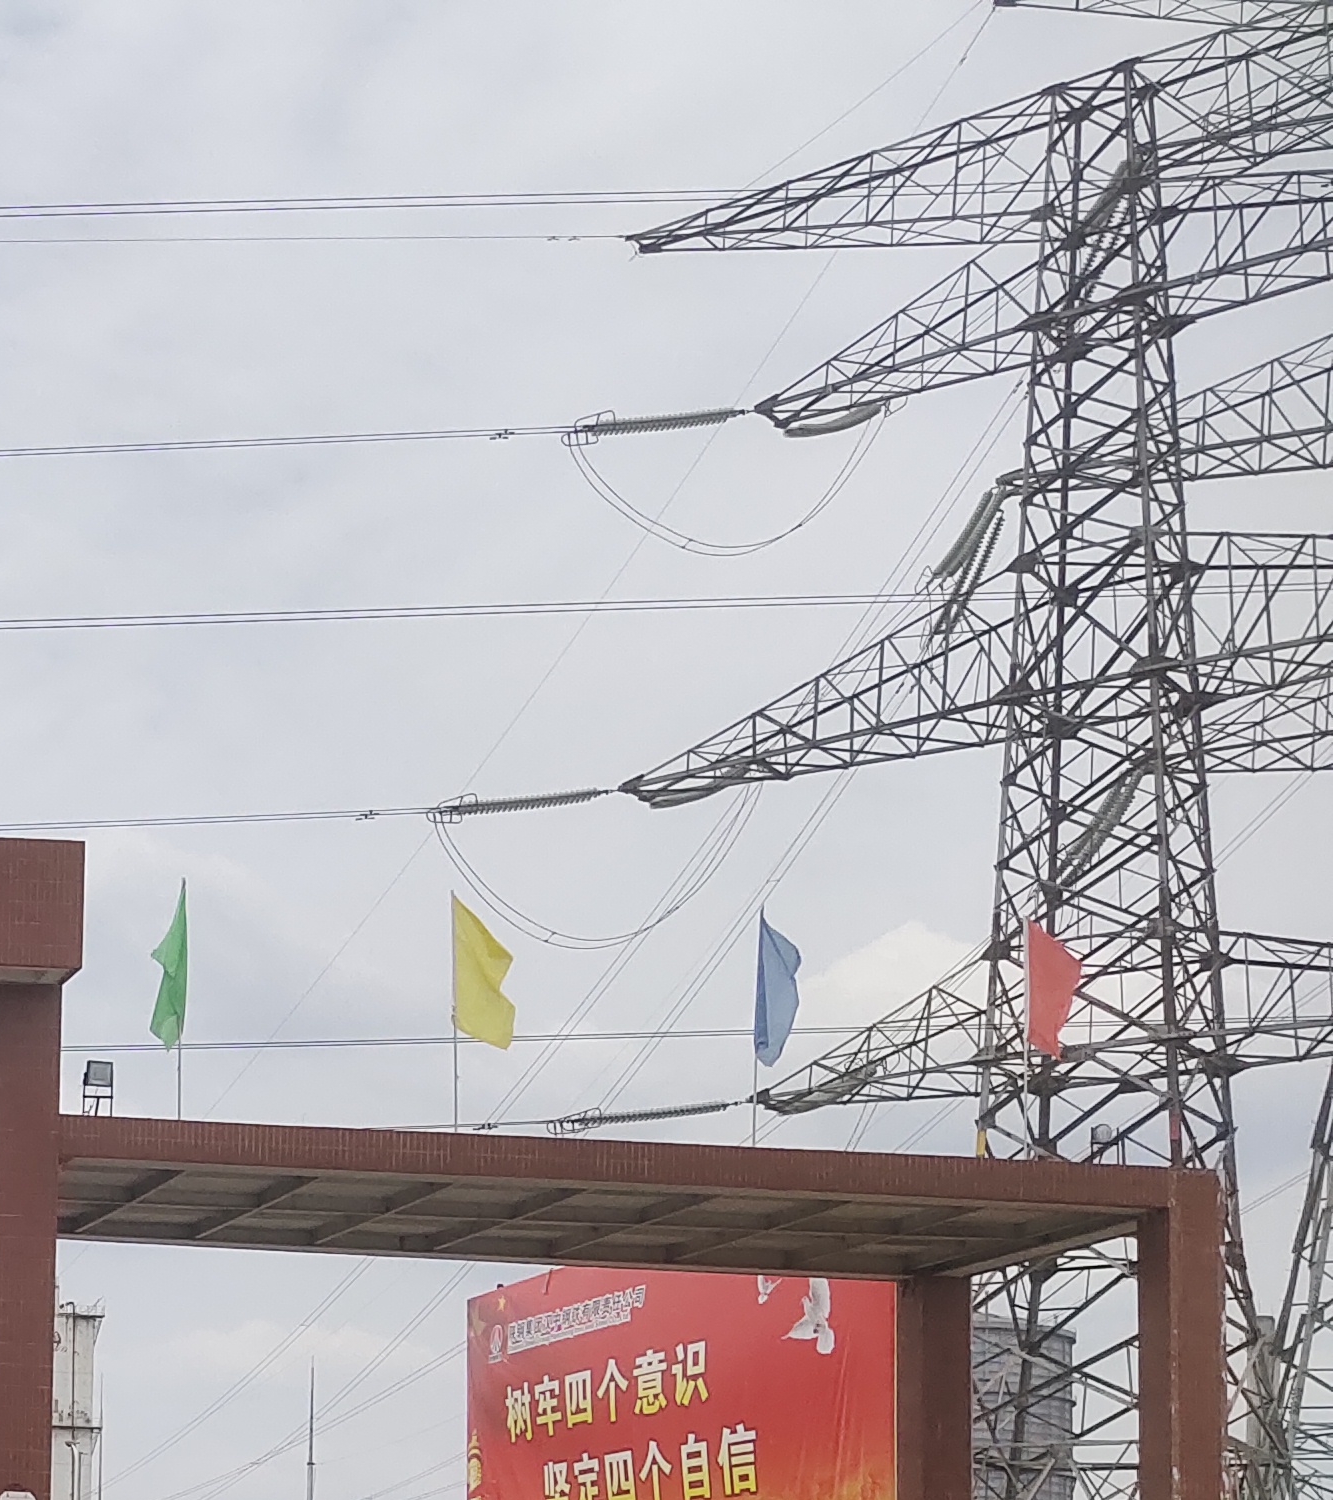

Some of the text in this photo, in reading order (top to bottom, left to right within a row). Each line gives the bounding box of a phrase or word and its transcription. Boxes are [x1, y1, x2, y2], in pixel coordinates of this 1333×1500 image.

[504, 1341, 710, 1443] 树牢四个意识
